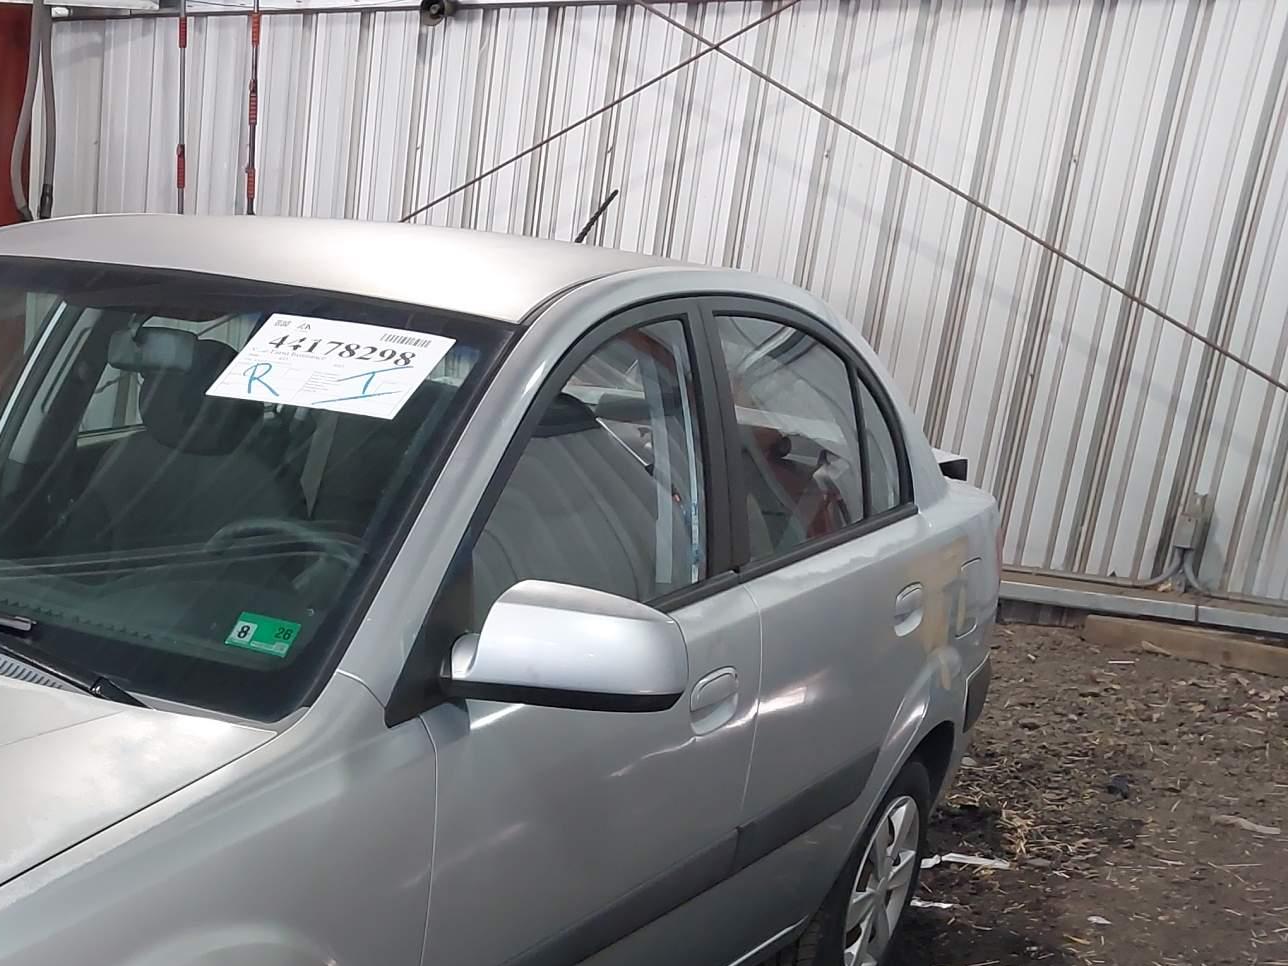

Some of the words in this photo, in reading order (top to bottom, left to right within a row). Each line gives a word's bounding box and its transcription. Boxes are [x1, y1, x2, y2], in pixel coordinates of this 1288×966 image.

[268, 334, 417, 367] 44178298
[243, 362, 279, 397] R
[237, 625, 251, 639] 8
